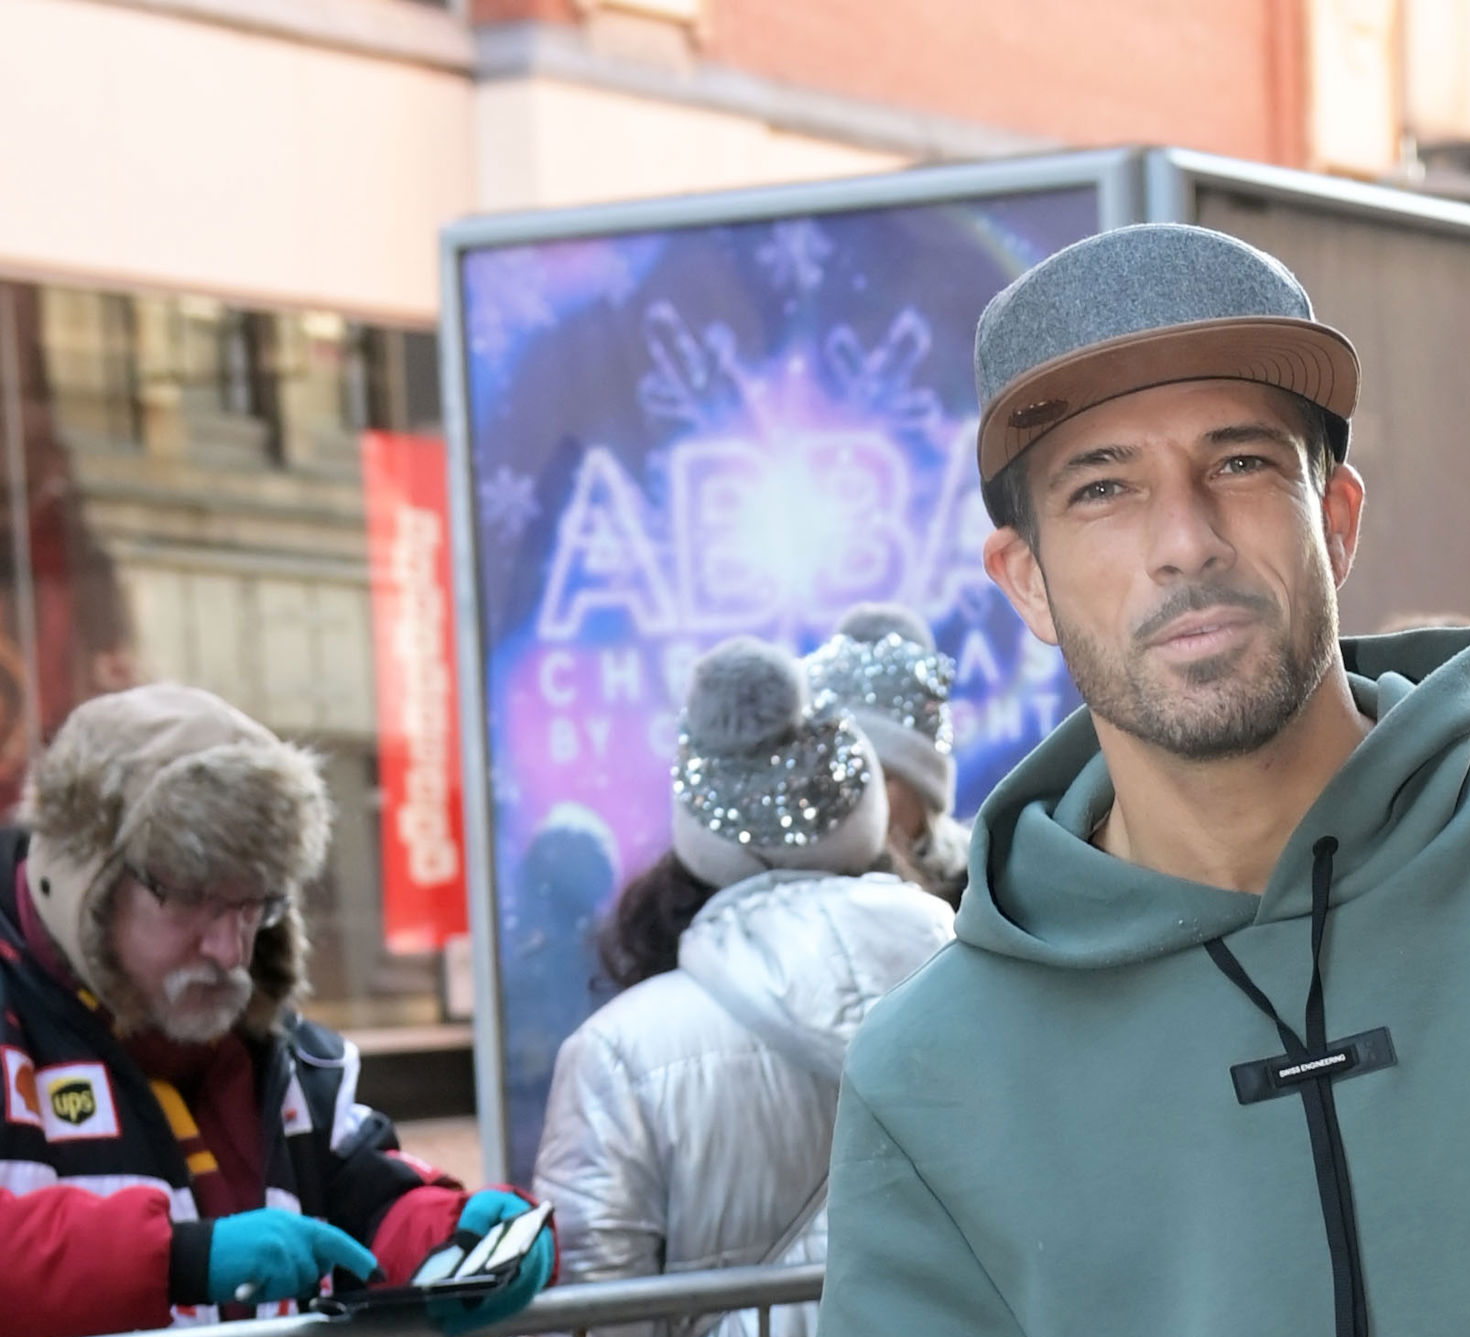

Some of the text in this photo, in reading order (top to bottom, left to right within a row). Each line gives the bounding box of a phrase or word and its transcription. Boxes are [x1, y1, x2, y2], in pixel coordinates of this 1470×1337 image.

[550, 716, 611, 764] BY
[1301, 1053, 1346, 1072] ENGINEERING
[55, 1090, 93, 1121] ups
